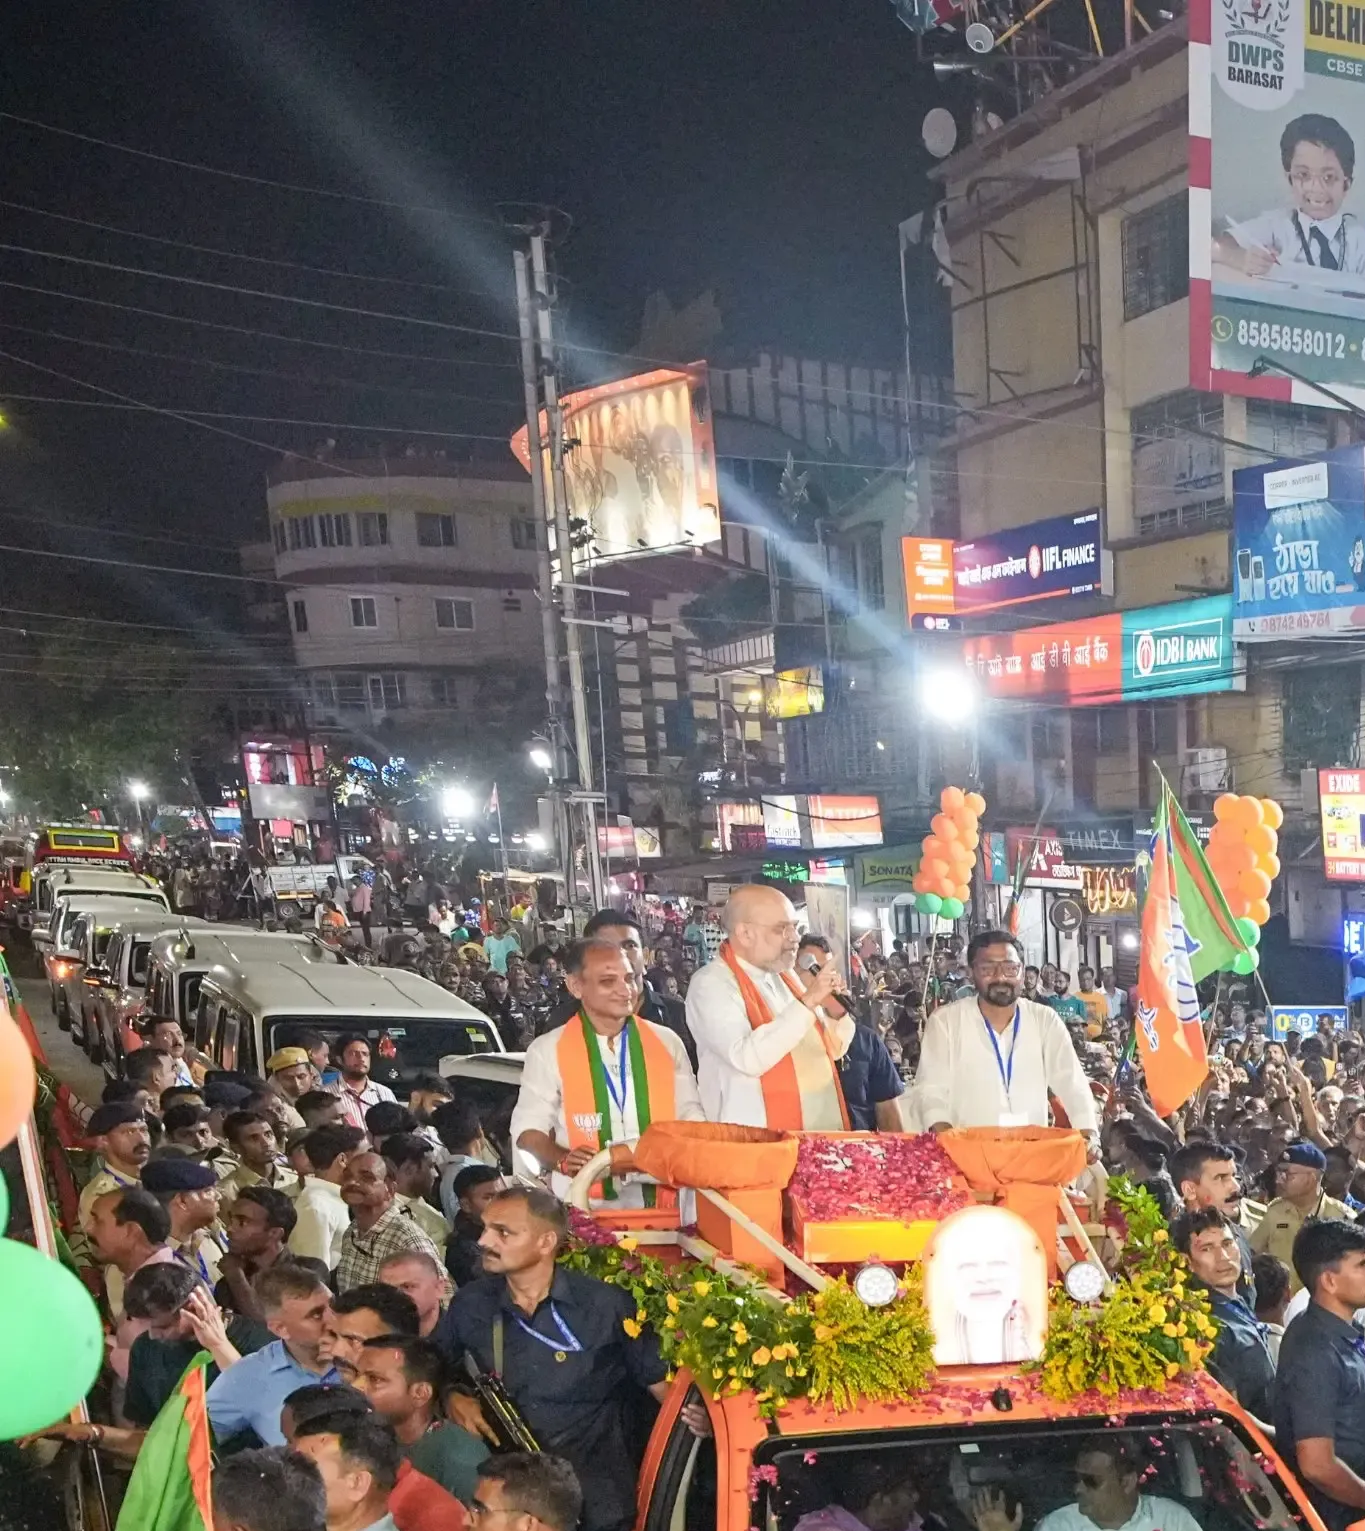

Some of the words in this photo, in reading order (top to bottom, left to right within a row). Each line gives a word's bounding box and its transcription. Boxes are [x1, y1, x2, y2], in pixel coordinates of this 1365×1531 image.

[1228, 40, 1284, 73] DWPS
[1326, 58, 1363, 78] CBSE
[1228, 65, 1284, 91] BARASAT
[1238, 319, 1346, 359] 8585858012
[1062, 543, 1096, 567] FINANCE
[1031, 643, 1046, 674] आई
[1074, 635, 1091, 669] आई
[1157, 635, 1185, 667] IDBI
[1187, 636, 1218, 662] BANK
[1328, 774, 1360, 793] EXIDE
[1066, 828, 1123, 851] TIMEX
[869, 864, 913, 878] SONATA
